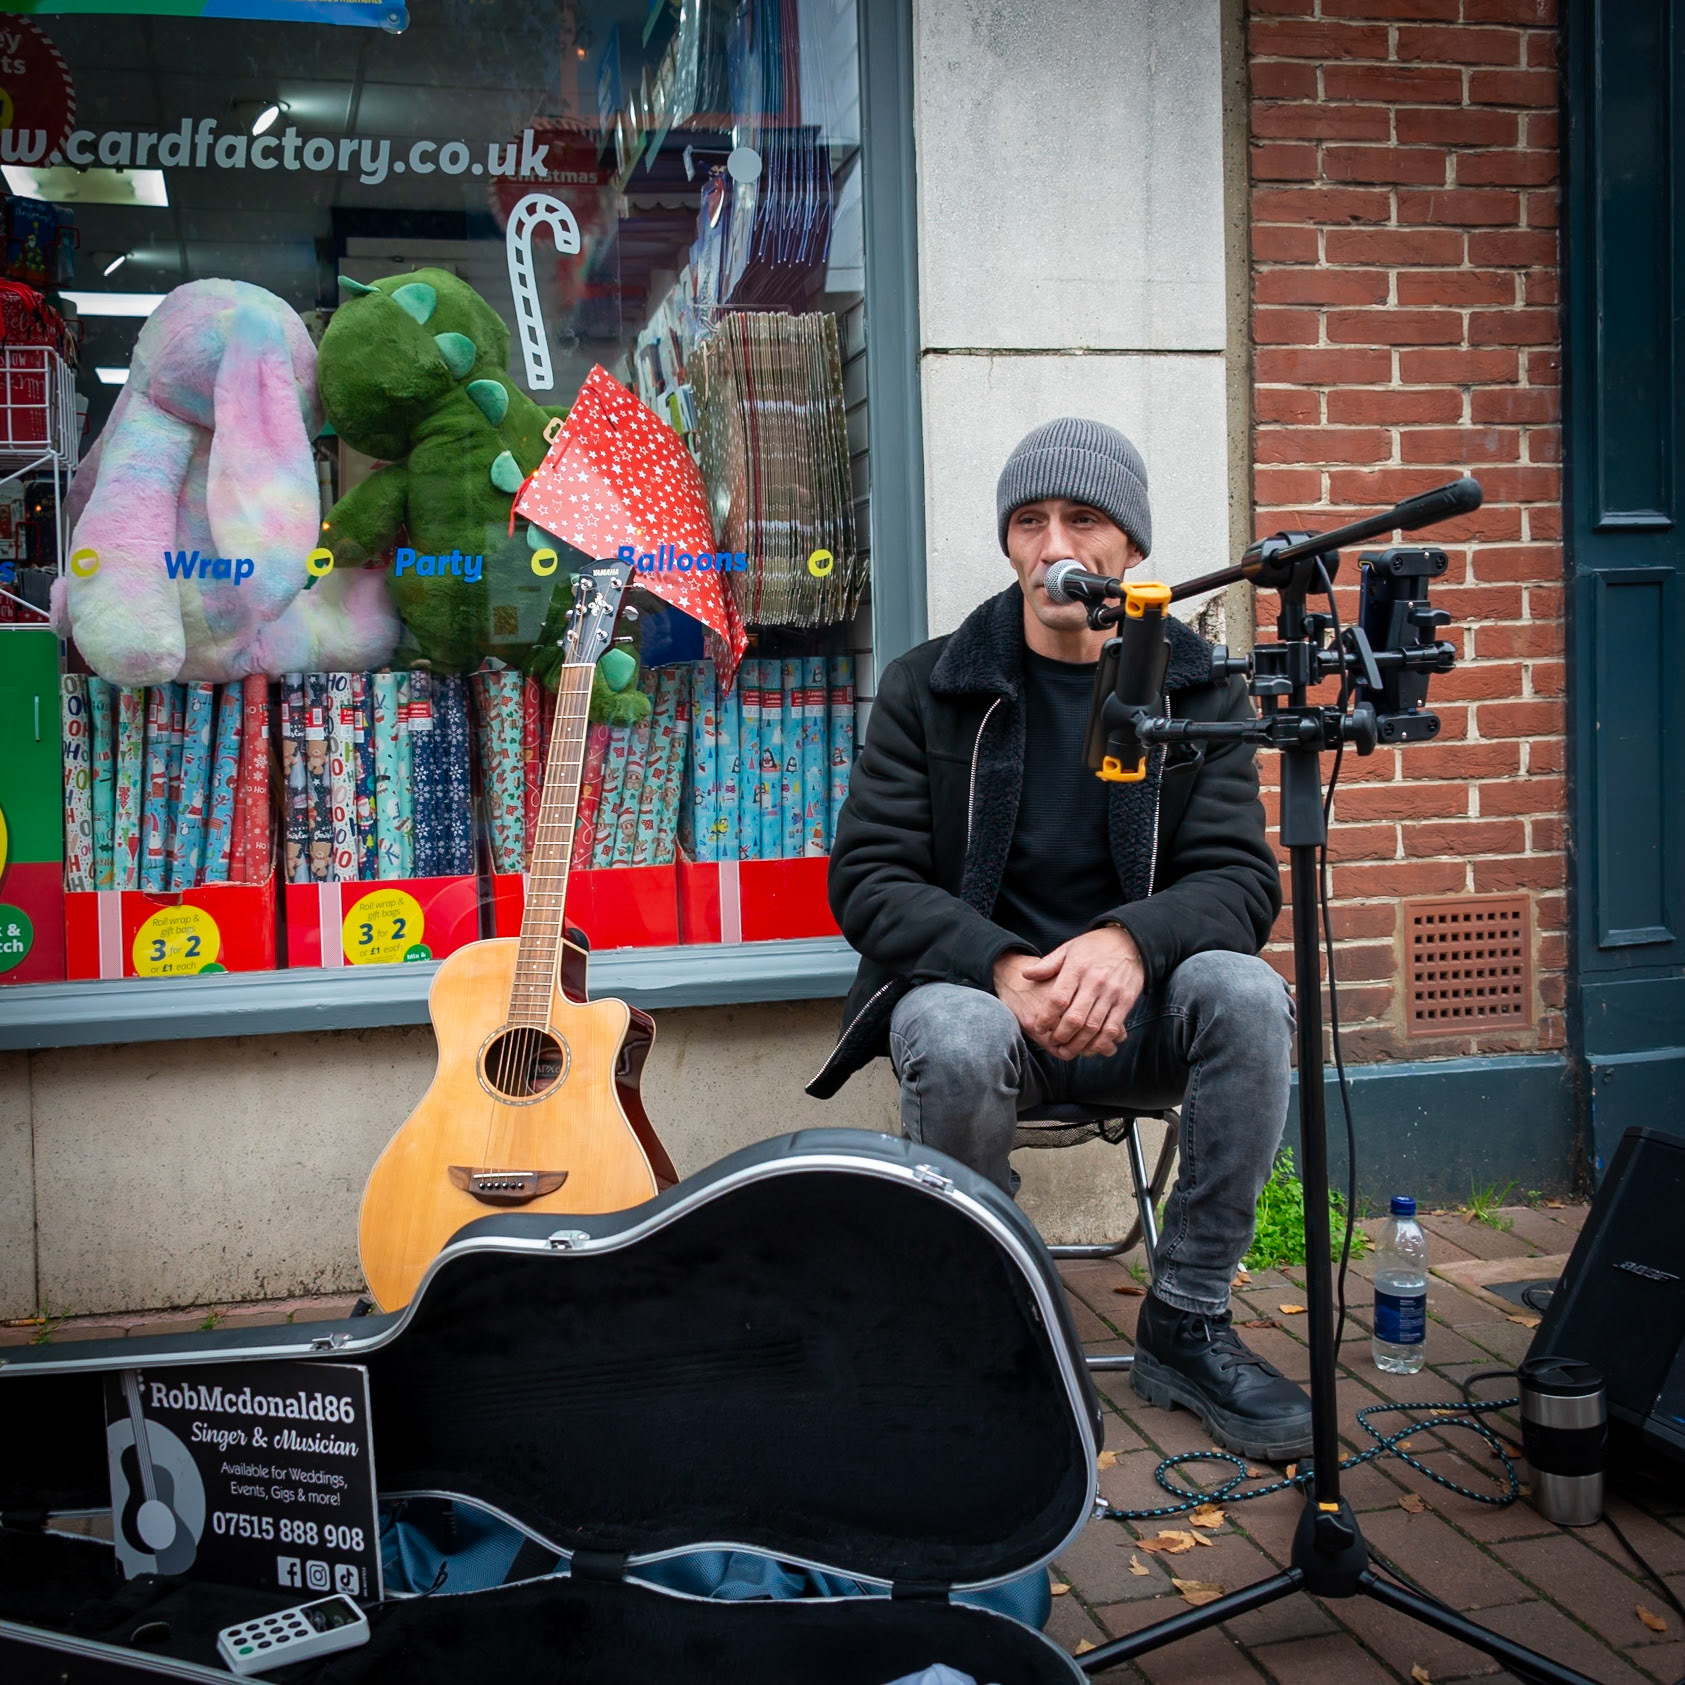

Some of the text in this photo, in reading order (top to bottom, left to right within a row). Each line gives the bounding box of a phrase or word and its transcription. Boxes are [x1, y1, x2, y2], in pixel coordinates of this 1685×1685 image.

[1, 118, 549, 185] w.cardfactory.co.uk
[164, 550, 254, 586] Wrap
[395, 547, 482, 583] Party
[617, 545, 748, 573] Balloons
[592, 568, 620, 577] YAMAHA
[359, 898, 405, 911] Roll wrap &
[367, 908, 401, 922] gift bags
[152, 914, 200, 927] Roll wrap &
[160, 924, 196, 938] gift bags
[358, 917, 406, 945] 3 for 2
[150, 935, 201, 961] 3 for 2
[359, 944, 402, 957] or £1 each
[406, 952, 420, 960] Mix
[162, 963, 173, 972] £1
[176, 961, 196, 971] each
[150, 1382, 355, 1424] RobMcdonald86
[191, 1421, 359, 1457] Singer & Musician
[220, 1461, 348, 1489] Available for Weddings,
[230, 1481, 341, 1506] Events, Gigs & more!
[212, 1511, 365, 1552] 07515 888 908
